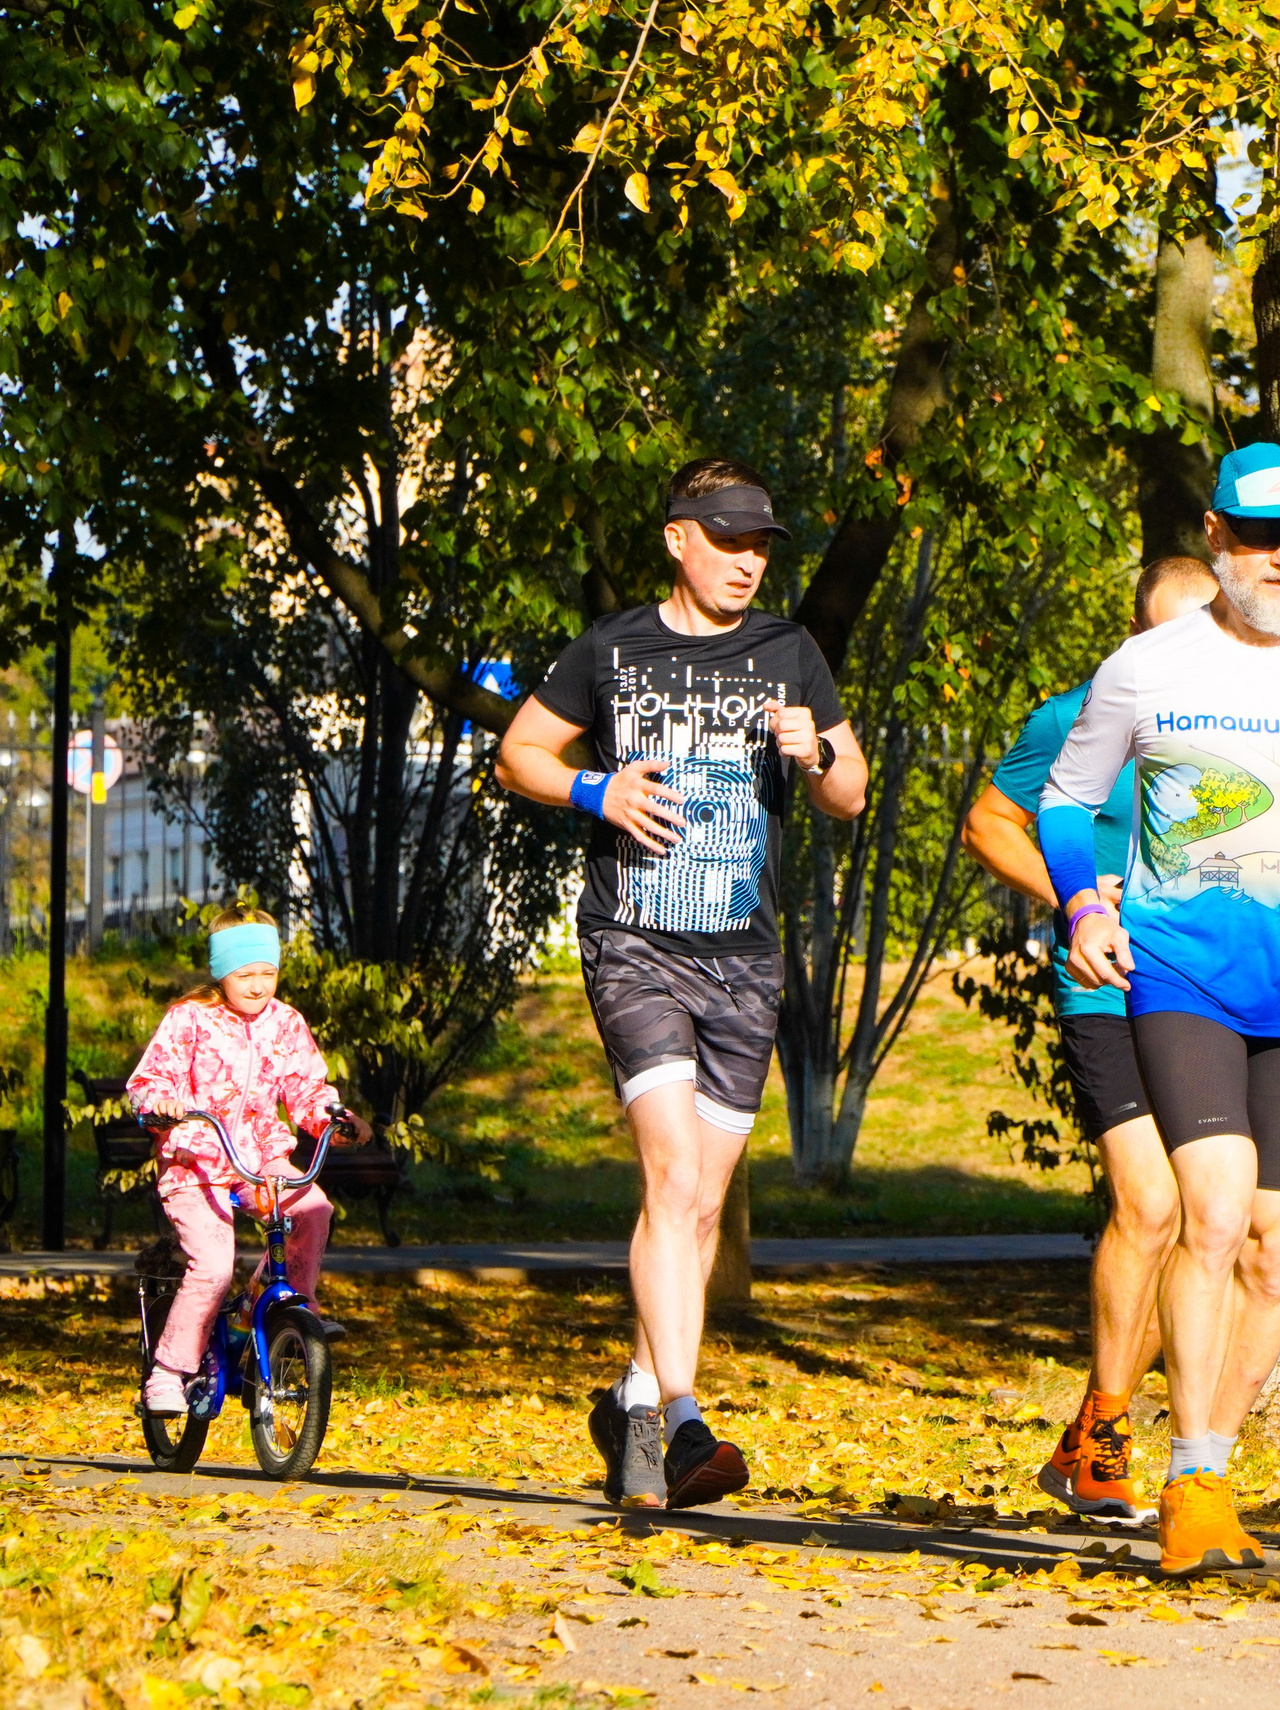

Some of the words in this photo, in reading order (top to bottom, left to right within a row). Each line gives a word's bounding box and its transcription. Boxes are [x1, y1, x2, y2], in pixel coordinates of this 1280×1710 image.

[620, 667, 628, 692] 13.07
[628, 666, 637, 691] 2019
[699, 716, 764, 727] ЗАБЕГ
[1198, 1116, 1228, 1125] EVADICT
